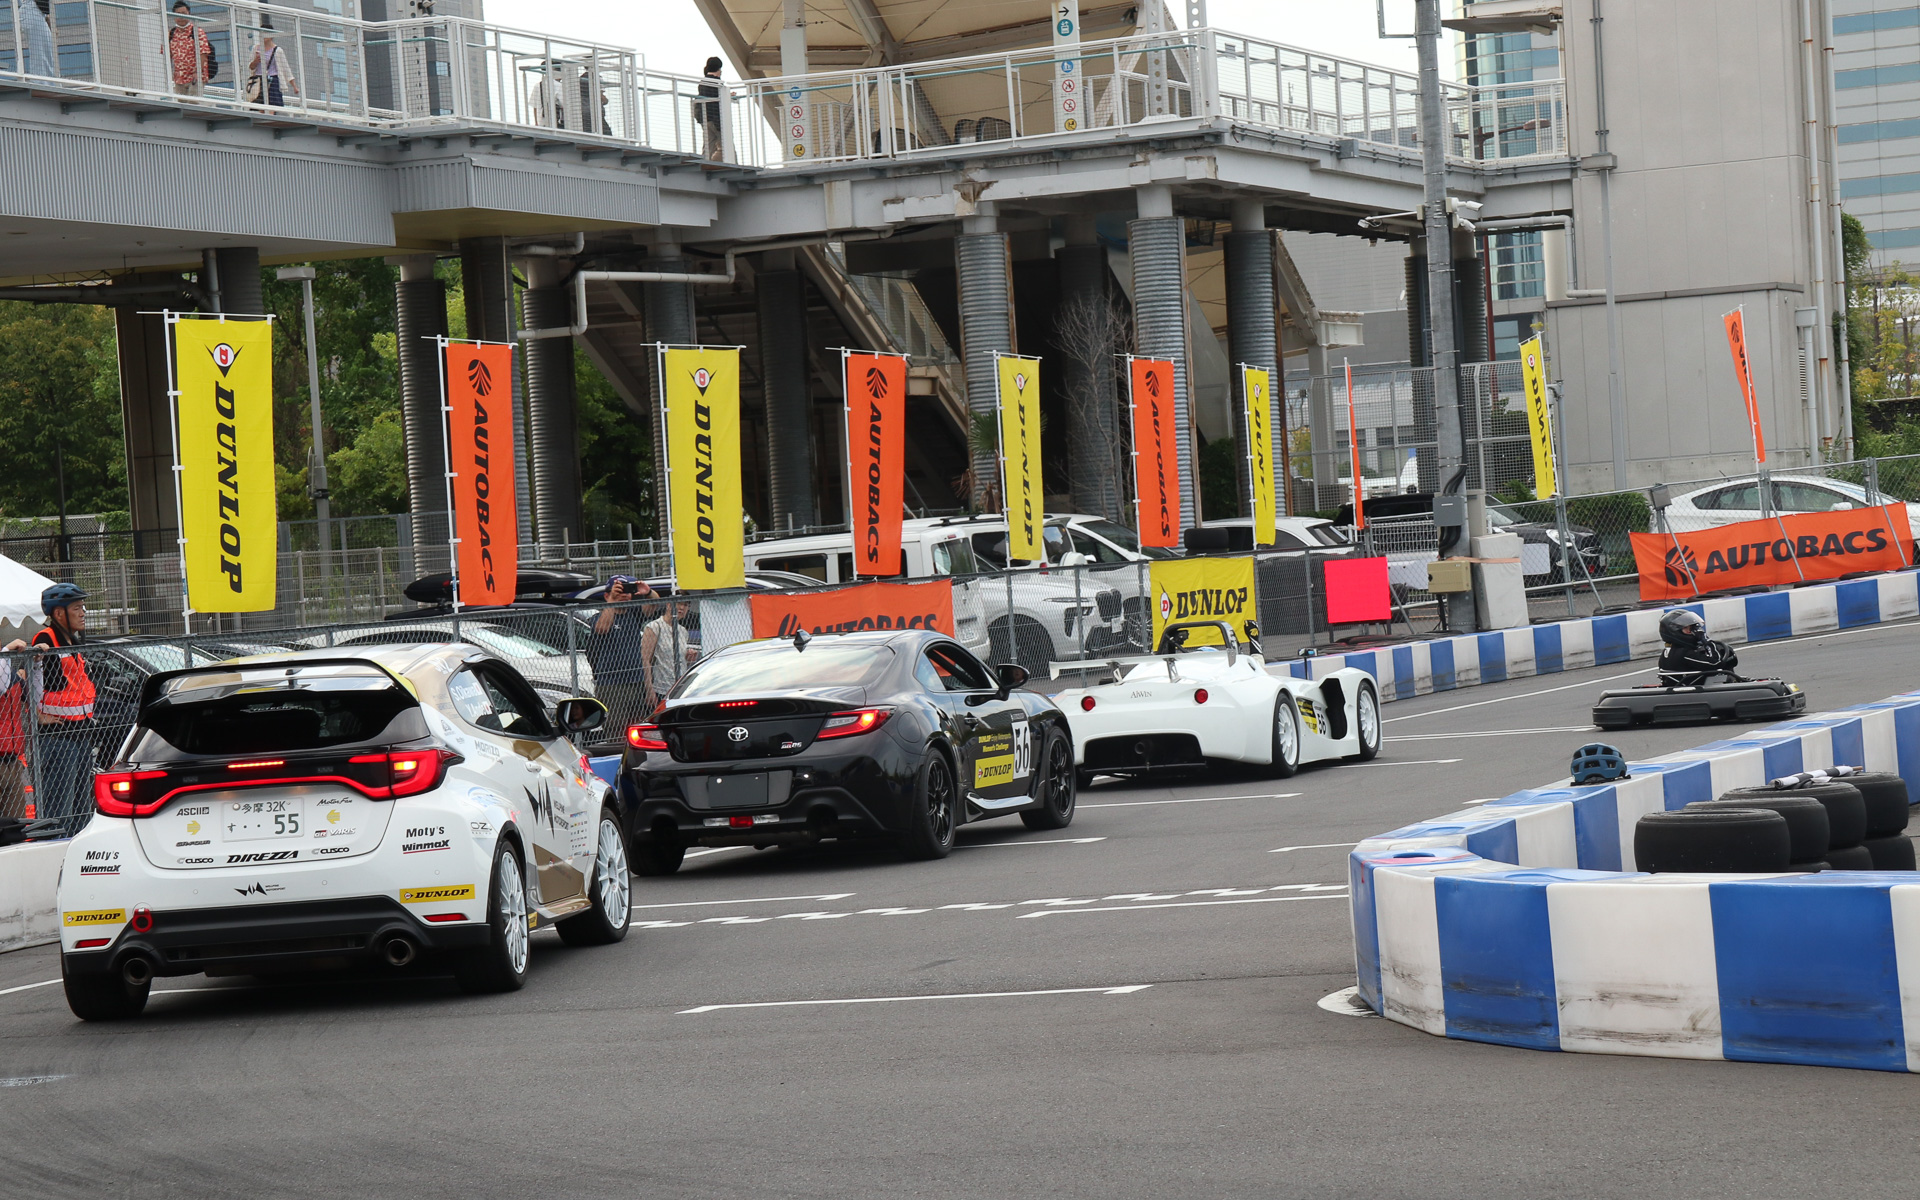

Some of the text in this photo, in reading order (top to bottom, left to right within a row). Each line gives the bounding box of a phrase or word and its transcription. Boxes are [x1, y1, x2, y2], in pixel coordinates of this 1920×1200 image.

[1018, 400, 1033, 546] DUNLOP
[1151, 399, 1170, 538] AUTOBACS
[215, 380, 242, 594] DUNLOP
[694, 400, 715, 573] DUNLOP
[867, 401, 882, 564] AUTOBACS
[474, 398, 496, 593] AUTOBACS
[1704, 528, 1887, 574] AUTOBACS
[1176, 587, 1247, 619] DUNLOP
[812, 613, 937, 633] OBACS
[1317, 713, 1327, 735] 56
[1015, 727, 1029, 773] 56
[983, 763, 1012, 778] DUNLOP
[241, 800, 286, 814] 多摩 32K
[274, 813, 299, 835] 55
[406, 826, 445, 838] Moty's
[85, 850, 120, 860] Moty's
[227, 850, 299, 864] DIREZZA
[414, 889, 470, 899] DUNLOP
[75, 913, 121, 922] DUNLOP
